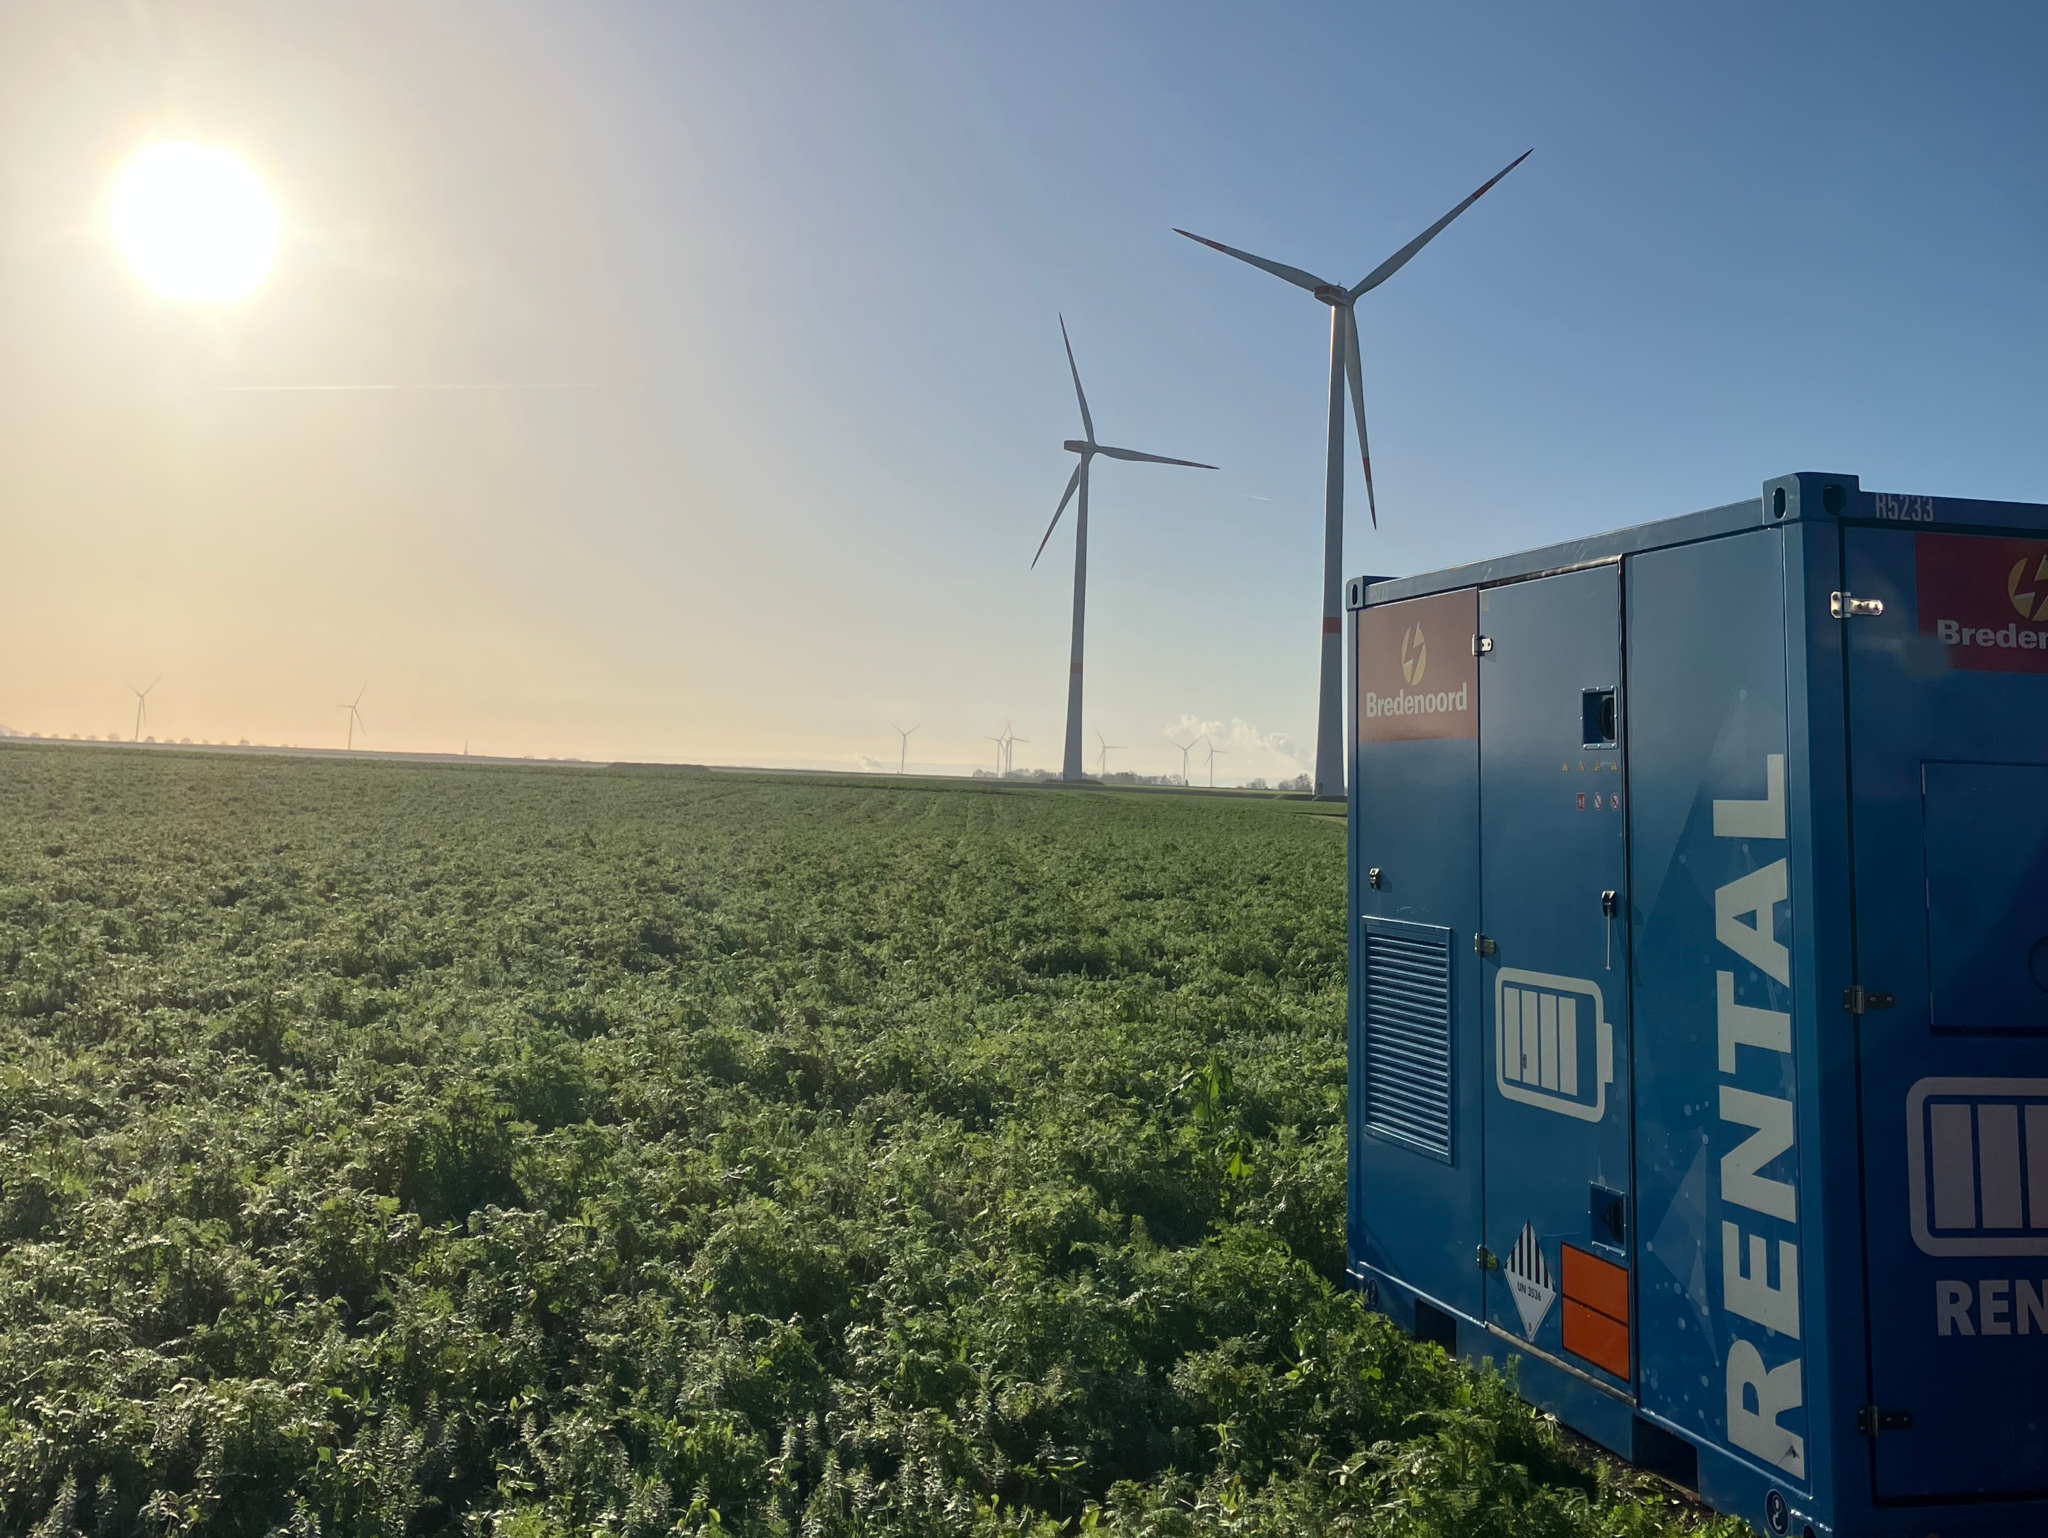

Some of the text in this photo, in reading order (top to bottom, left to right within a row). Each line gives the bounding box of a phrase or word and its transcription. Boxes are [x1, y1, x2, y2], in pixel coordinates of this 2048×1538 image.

[1875, 493, 1934, 522] R5233
[1366, 682, 1467, 718] Bredenoord
[1712, 754, 1804, 1480] RENTAL
[1517, 1282, 1527, 1295] UN
